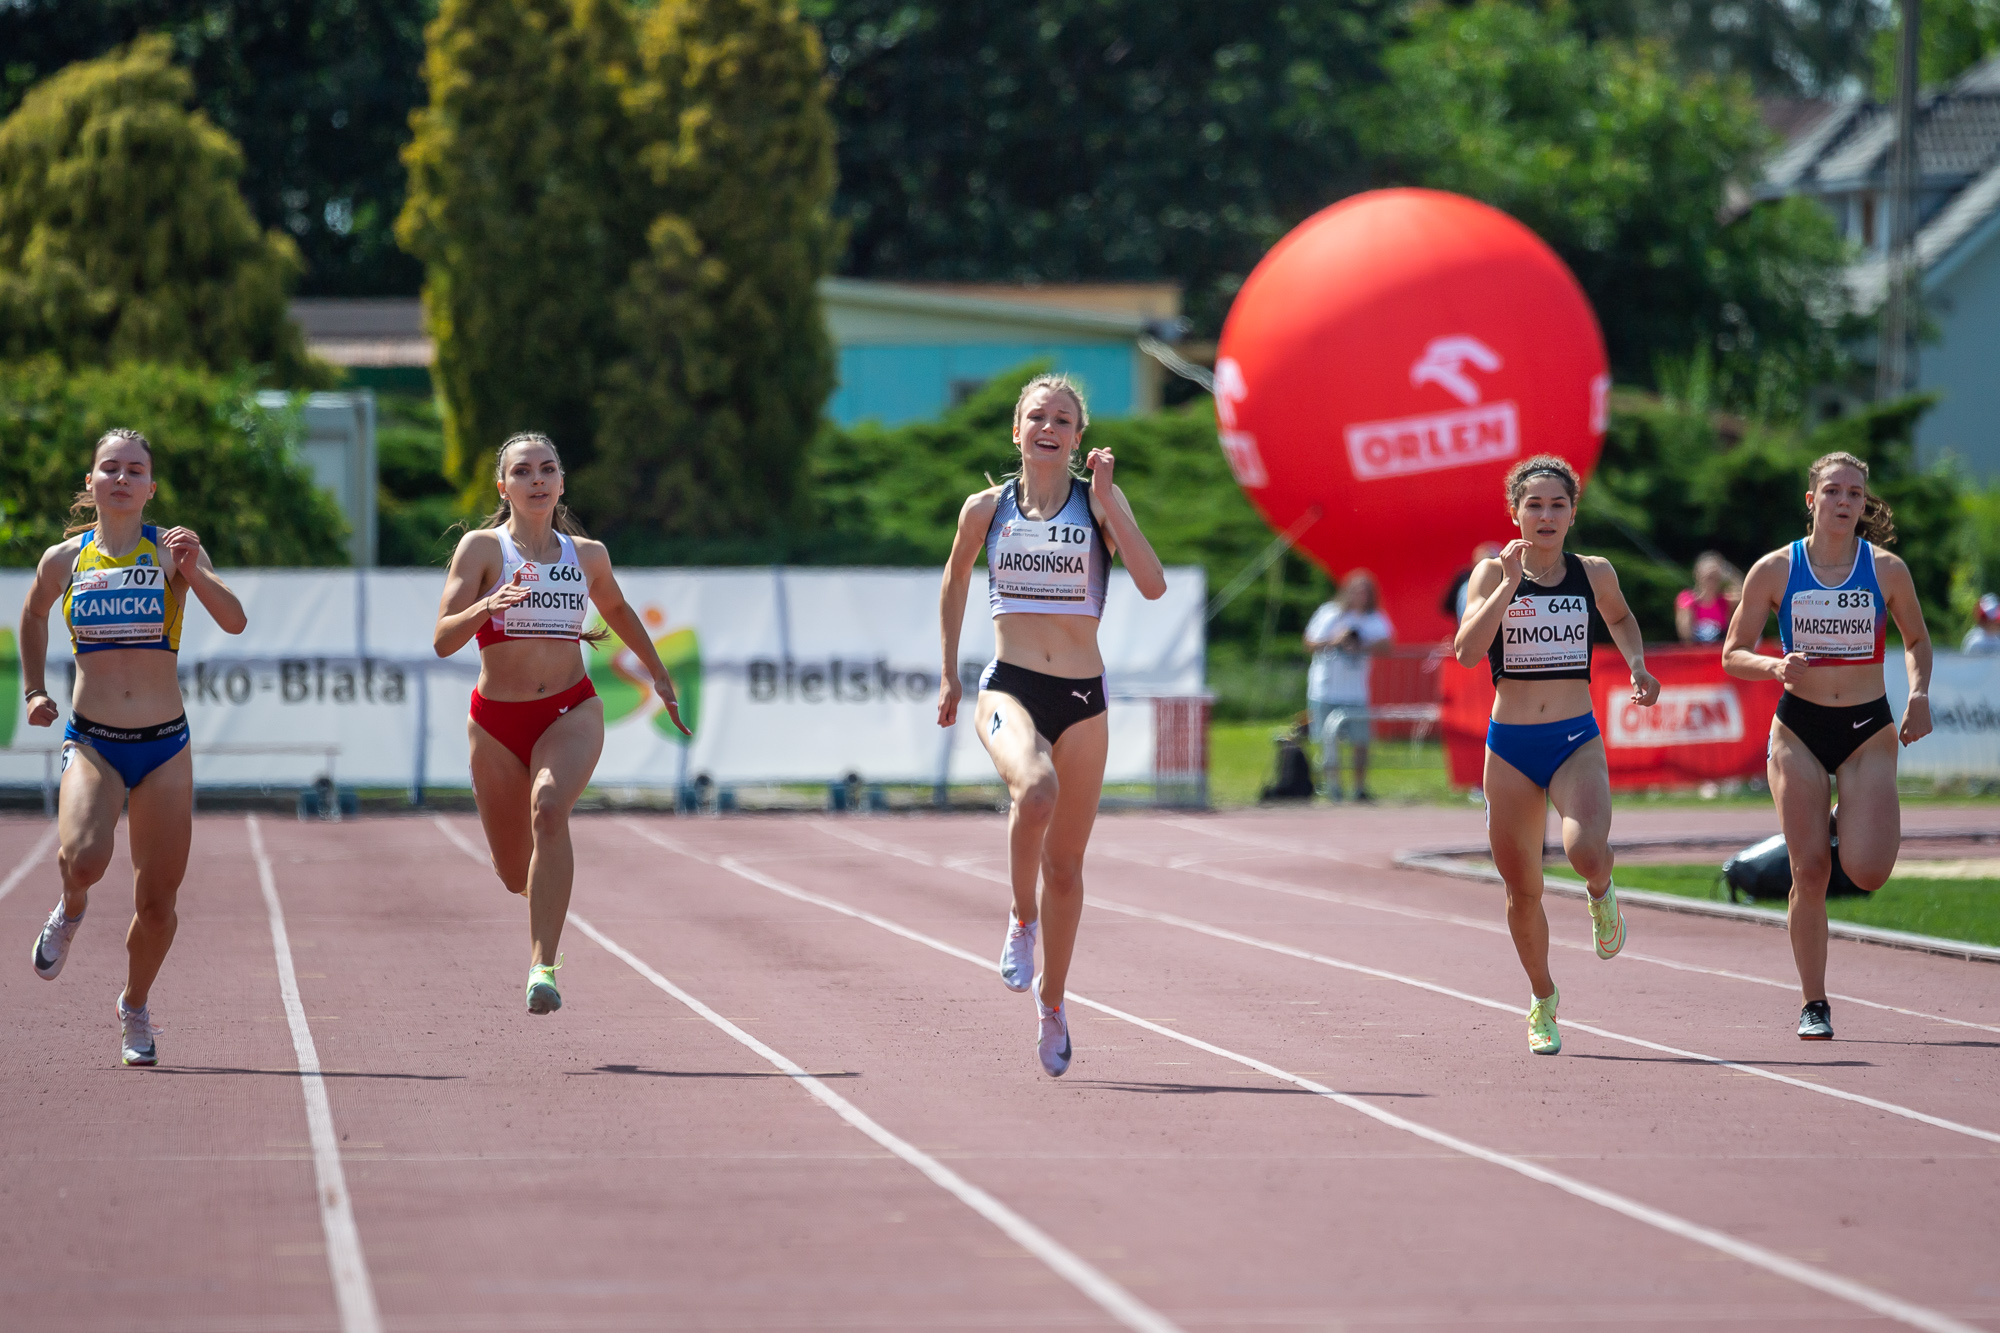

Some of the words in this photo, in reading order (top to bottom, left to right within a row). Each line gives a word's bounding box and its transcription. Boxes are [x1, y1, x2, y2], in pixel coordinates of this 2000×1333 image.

[1361, 417, 1505, 467] ORLEN
[1047, 525, 1086, 545] 110
[997, 551, 1085, 574] JAROSIŃSKA
[122, 568, 160, 586] 707
[549, 565, 583, 582] 660
[1020, 586, 1055, 594] Mistrzostwa
[74, 597, 162, 617] KANICKA
[511, 591, 585, 611] HROSTEK
[1547, 598, 1583, 614] 644
[1837, 592, 1870, 608] 833
[1509, 609, 1535, 617] ORLEN
[1505, 624, 1585, 645] ZIMOLĄG
[1794, 617, 1872, 635] MARSZEWSKA
[1529, 655, 1563, 663] Mistrzostwa
